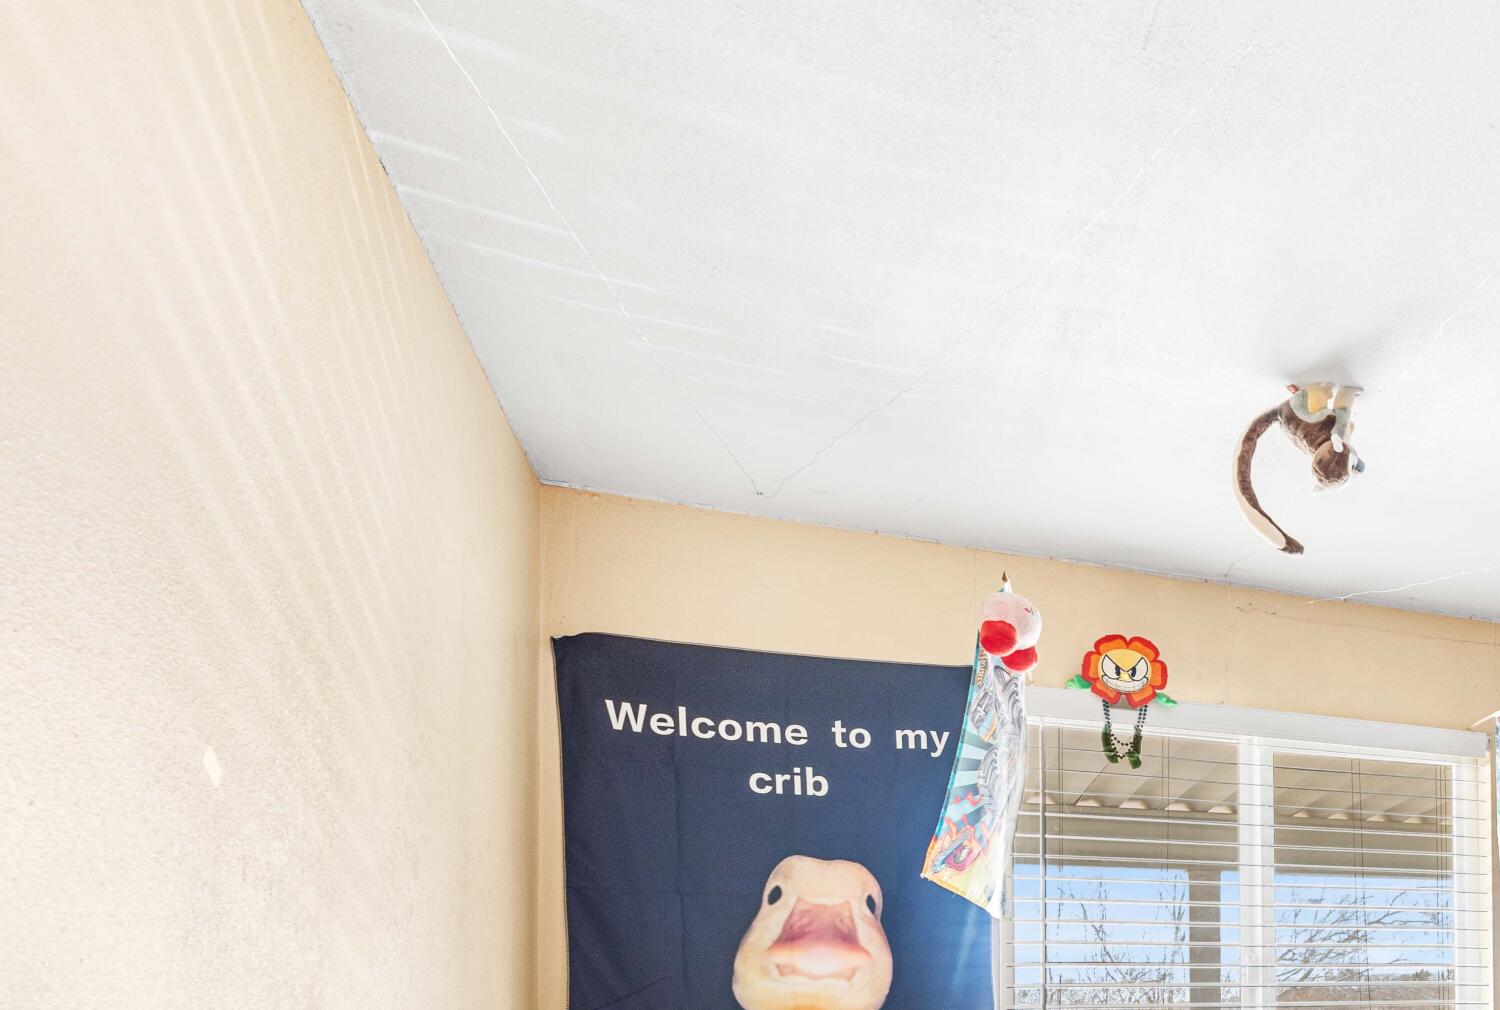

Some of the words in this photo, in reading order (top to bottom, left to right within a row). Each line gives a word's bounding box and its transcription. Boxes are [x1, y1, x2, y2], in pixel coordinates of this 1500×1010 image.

[604, 698, 809, 745] Welcome
[831, 719, 872, 750] to
[895, 726, 950, 757] my
[748, 766, 829, 798] crib
